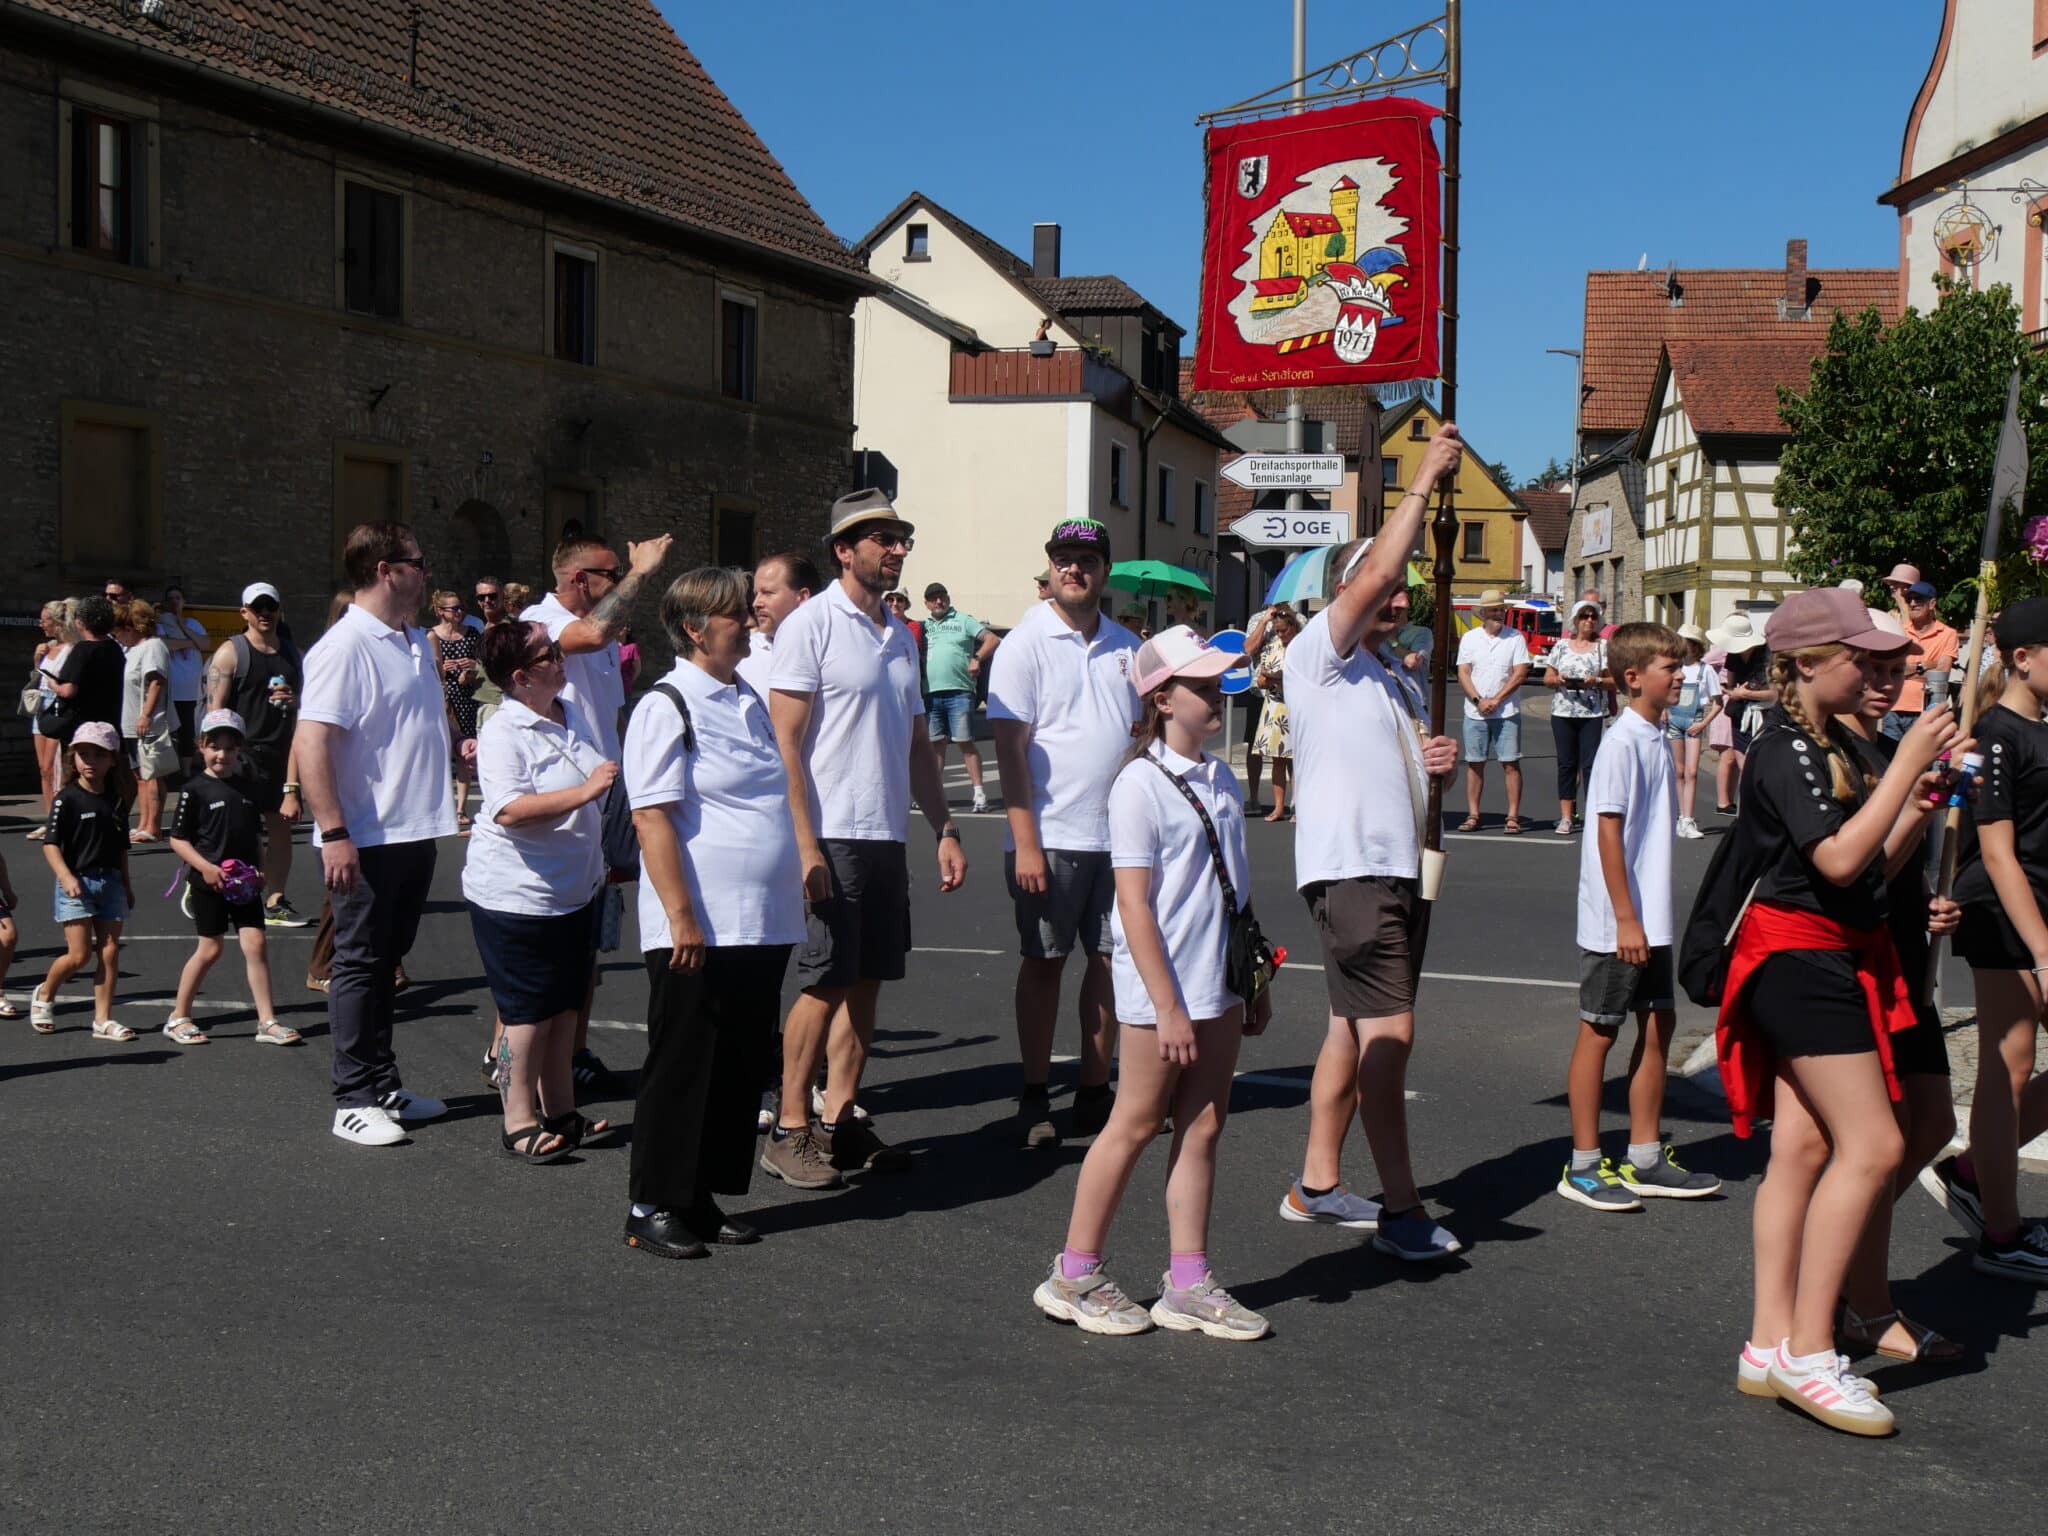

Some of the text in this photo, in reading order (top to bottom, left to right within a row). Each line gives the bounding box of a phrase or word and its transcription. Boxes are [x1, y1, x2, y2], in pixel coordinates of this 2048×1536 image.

[1338, 329, 1371, 351] 1971
[1262, 367, 1314, 382] Senatoren
[1250, 460, 1338, 471] Dreifachsporthalle
[1251, 473, 1312, 484] Tennisanlage
[1293, 521, 1331, 534] OGE
